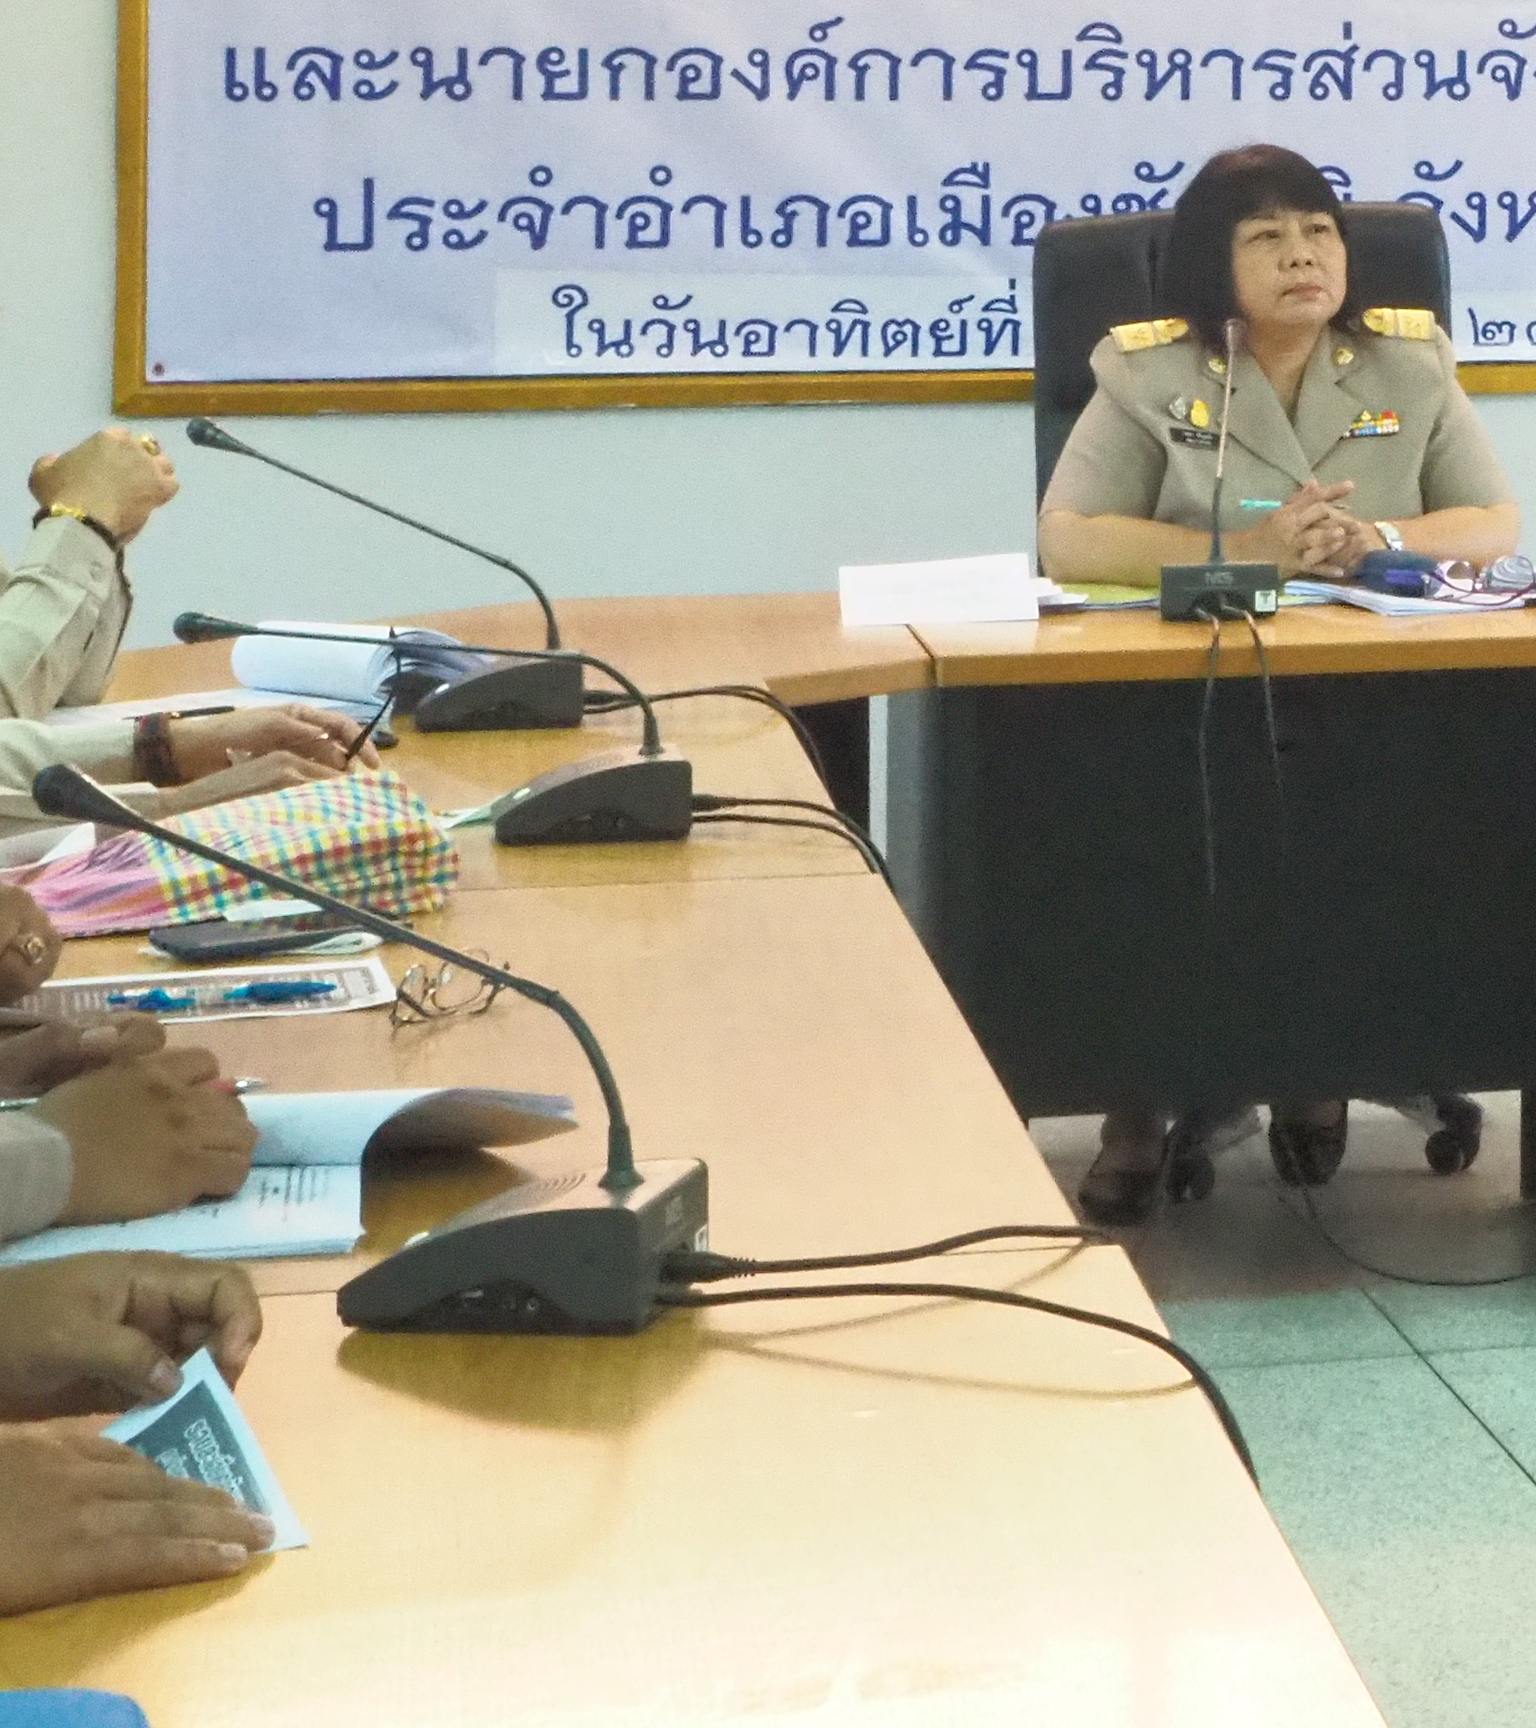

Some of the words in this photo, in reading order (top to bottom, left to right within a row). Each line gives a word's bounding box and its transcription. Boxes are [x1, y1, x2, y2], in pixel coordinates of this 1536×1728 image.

[550, 277, 1023, 359] ในวันอาทิตย์ที่
